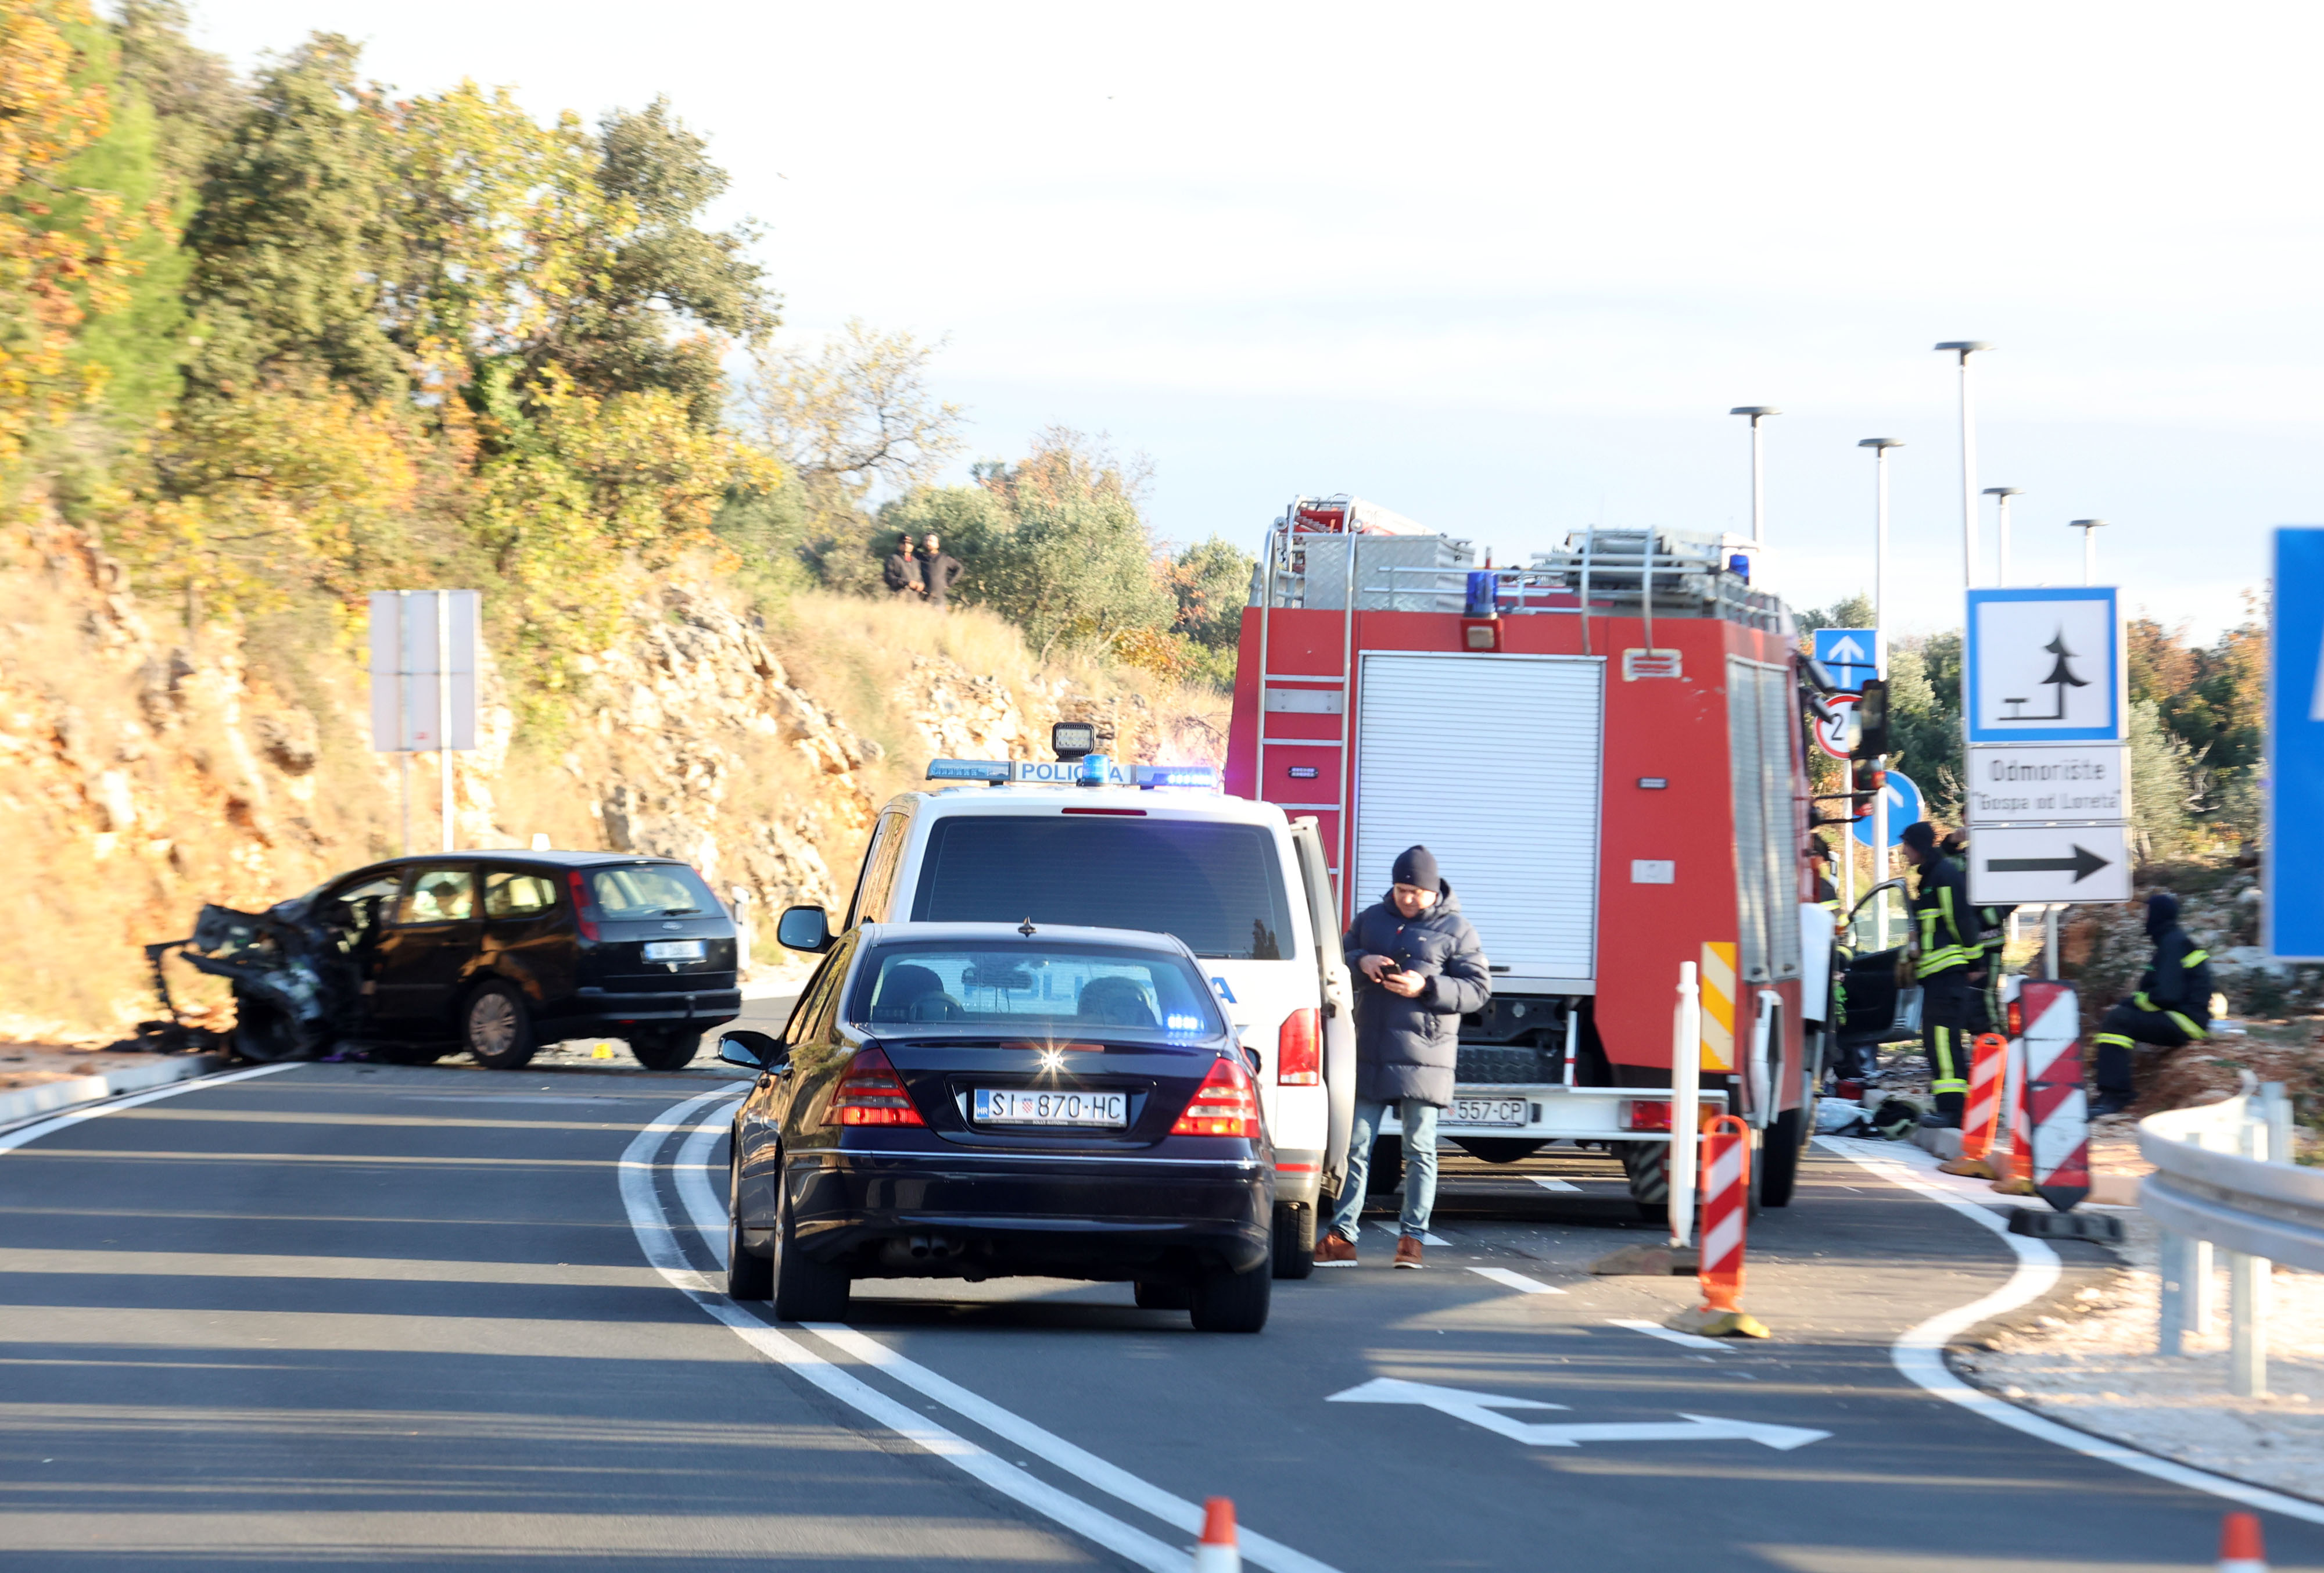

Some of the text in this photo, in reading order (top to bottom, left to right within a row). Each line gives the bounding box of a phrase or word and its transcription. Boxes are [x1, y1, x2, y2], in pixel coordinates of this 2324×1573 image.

[1831, 712, 1845, 741] 2
[1022, 763, 1124, 782] POLICA
[977, 1092, 1121, 1119] HR ŠI 870-HC
[1458, 1101, 1521, 1120] 557-CP
